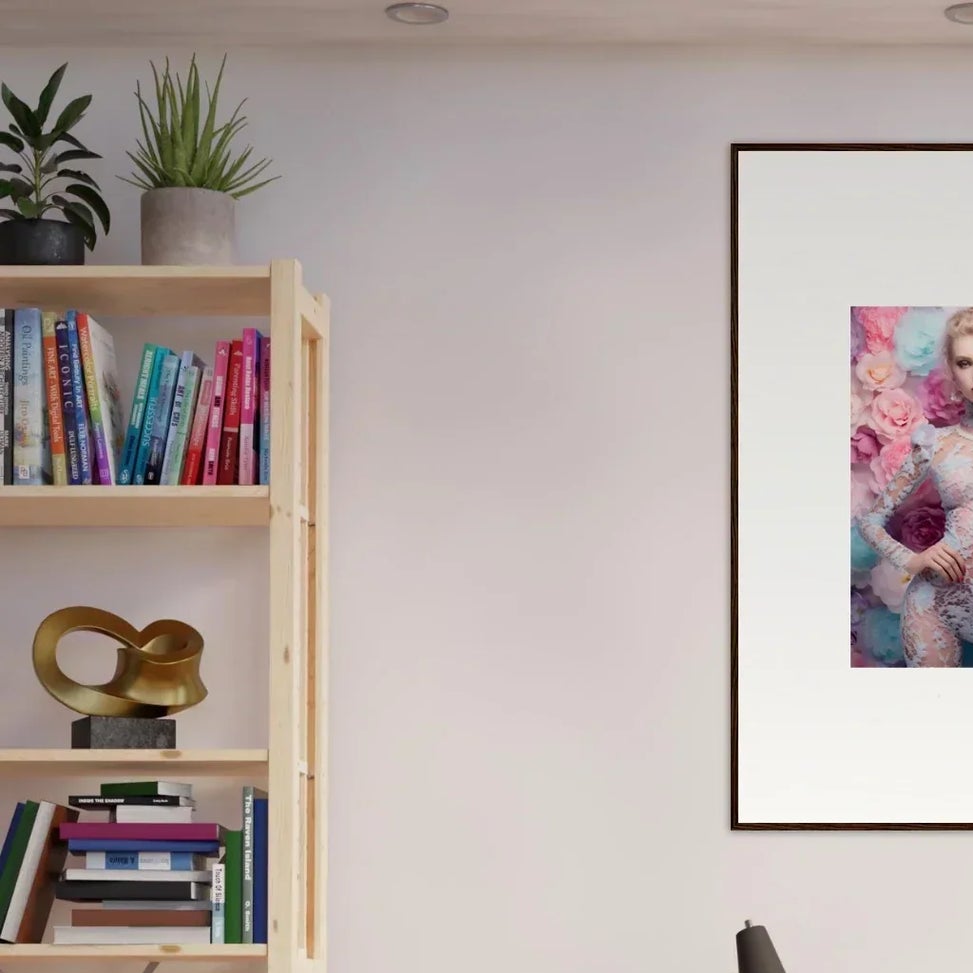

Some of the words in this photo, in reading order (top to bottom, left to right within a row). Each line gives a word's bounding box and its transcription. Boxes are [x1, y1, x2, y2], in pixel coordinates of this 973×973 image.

[22, 325, 32, 340] Oil
[47, 347, 55, 364] FINE
[71, 343, 79, 357] Find
[20, 342, 32, 386] Paintings
[48, 365, 56, 380] ART
[72, 358, 82, 384] Beauty
[82, 326, 93, 374] Watercolor
[88, 375, 97, 411] Portraits
[59, 344, 73, 408] ICONIC
[230, 363, 240, 396] Parenting
[50, 384, 58, 401] With
[75, 394, 83, 409] ART
[51, 403, 60, 426] Digital
[230, 397, 238, 415] Skills
[53, 426, 62, 443] Tools
[244, 816, 252, 847] Raven
[244, 849, 252, 880] Island
